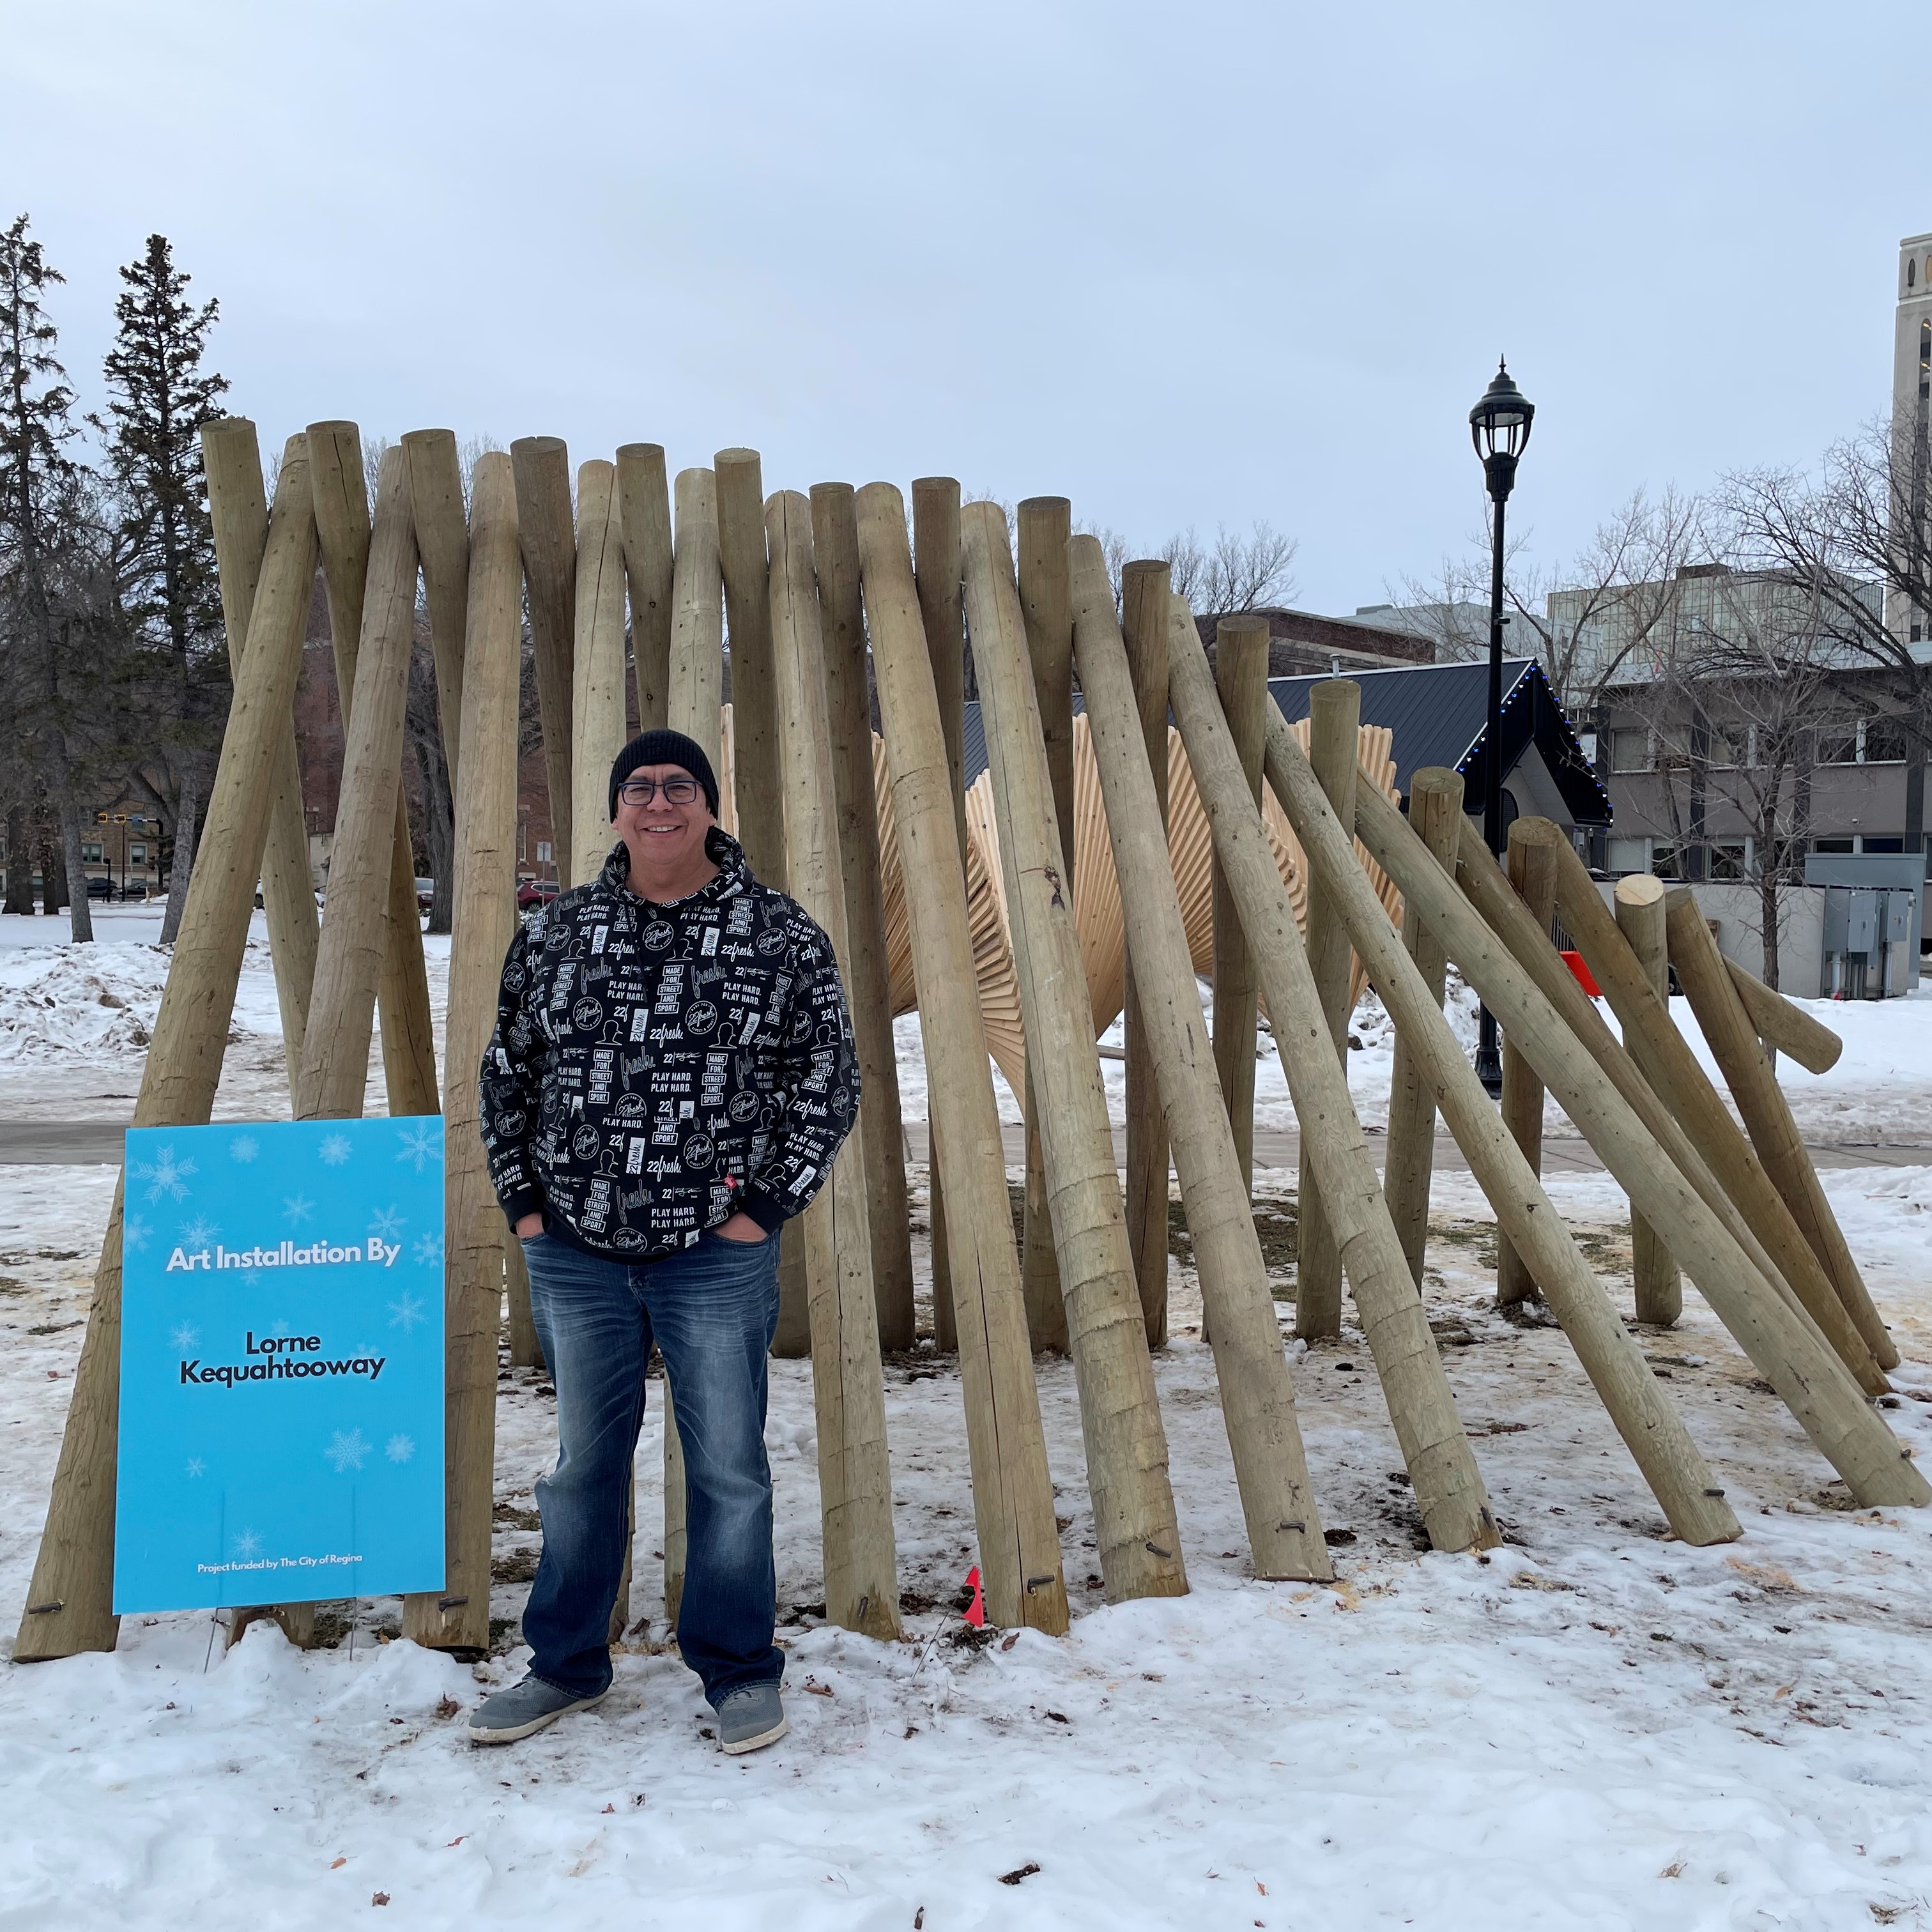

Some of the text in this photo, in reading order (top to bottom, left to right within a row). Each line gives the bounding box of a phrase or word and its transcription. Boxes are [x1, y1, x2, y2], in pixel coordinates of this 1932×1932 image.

[576, 913, 590, 921] PLAY
[786, 919, 802, 930] PLAY
[721, 942, 755, 962] 22fresh.
[609, 981, 627, 989] PLAY
[724, 982, 762, 996] PLAY HARD.
[608, 990, 625, 999] PLAY
[722, 992, 740, 1001] PLAY
[741, 995, 760, 1006] HARD.
[650, 1023, 684, 1048] 22fresh.
[652, 1072, 693, 1081] PLAY HARD.
[650, 1084, 668, 1092] PLAY
[804, 1081, 824, 1091] SPORT.
[590, 1093, 606, 1101] SPORT.
[793, 1098, 829, 1120] 22fresh.
[602, 1118, 643, 1128] PLAY HARD.
[654, 1134, 675, 1142] SPORT.
[790, 1133, 825, 1153] PLAY HARD.
[785, 1141, 820, 1162] PLAY HARD.
[647, 1155, 682, 1182] 22fresh.
[593, 1182, 608, 1191] MADE
[587, 1200, 608, 1211] STREET
[652, 1207, 697, 1217] PLAY HARD.
[583, 1220, 602, 1230] SPORT.
[651, 1218, 697, 1228] PLAY HARD.
[166, 1238, 401, 1271] Art Installation By
[247, 1331, 321, 1354] Lorne
[181, 1355, 386, 1388] Kequahtooway
[197, 1553, 363, 1574] Project funded by The City of Regina
